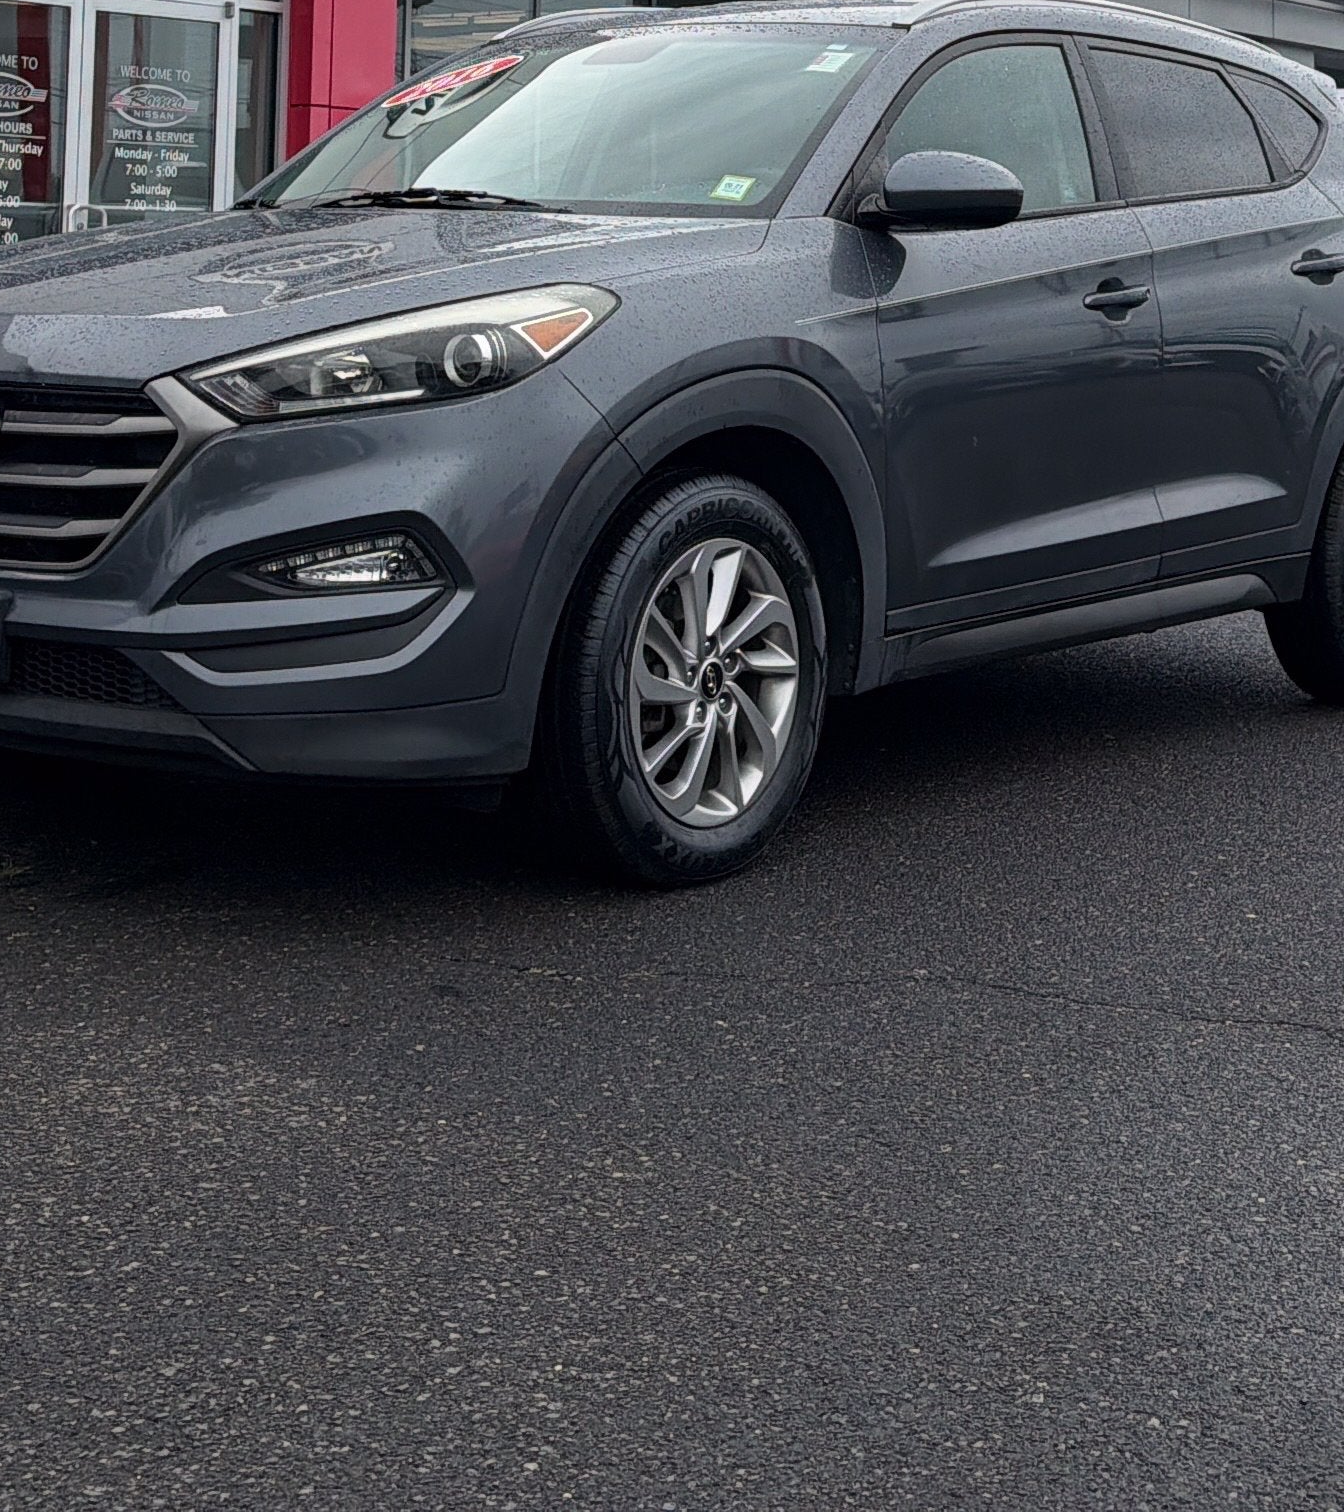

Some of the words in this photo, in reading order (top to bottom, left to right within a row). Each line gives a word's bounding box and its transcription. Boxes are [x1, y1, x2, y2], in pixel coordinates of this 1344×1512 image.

[21, 56, 38, 71] TO
[120, 65, 173, 82] WELCOME
[176, 69, 191, 83] TO
[126, 87, 185, 109] Romeo
[134, 109, 175, 120] NISSAN
[113, 128, 144, 141] PARTS
[145, 130, 153, 142] &
[155, 130, 195, 144] SERVICE
[115, 147, 153, 162] Monday
[160, 148, 190, 164] Friday
[125, 163, 148, 177] 7:00
[156, 165, 178, 178] 5:00
[130, 182, 173, 198] Saturday
[124, 199, 147, 211] 7:00
[155, 200, 177, 212] 1:30
